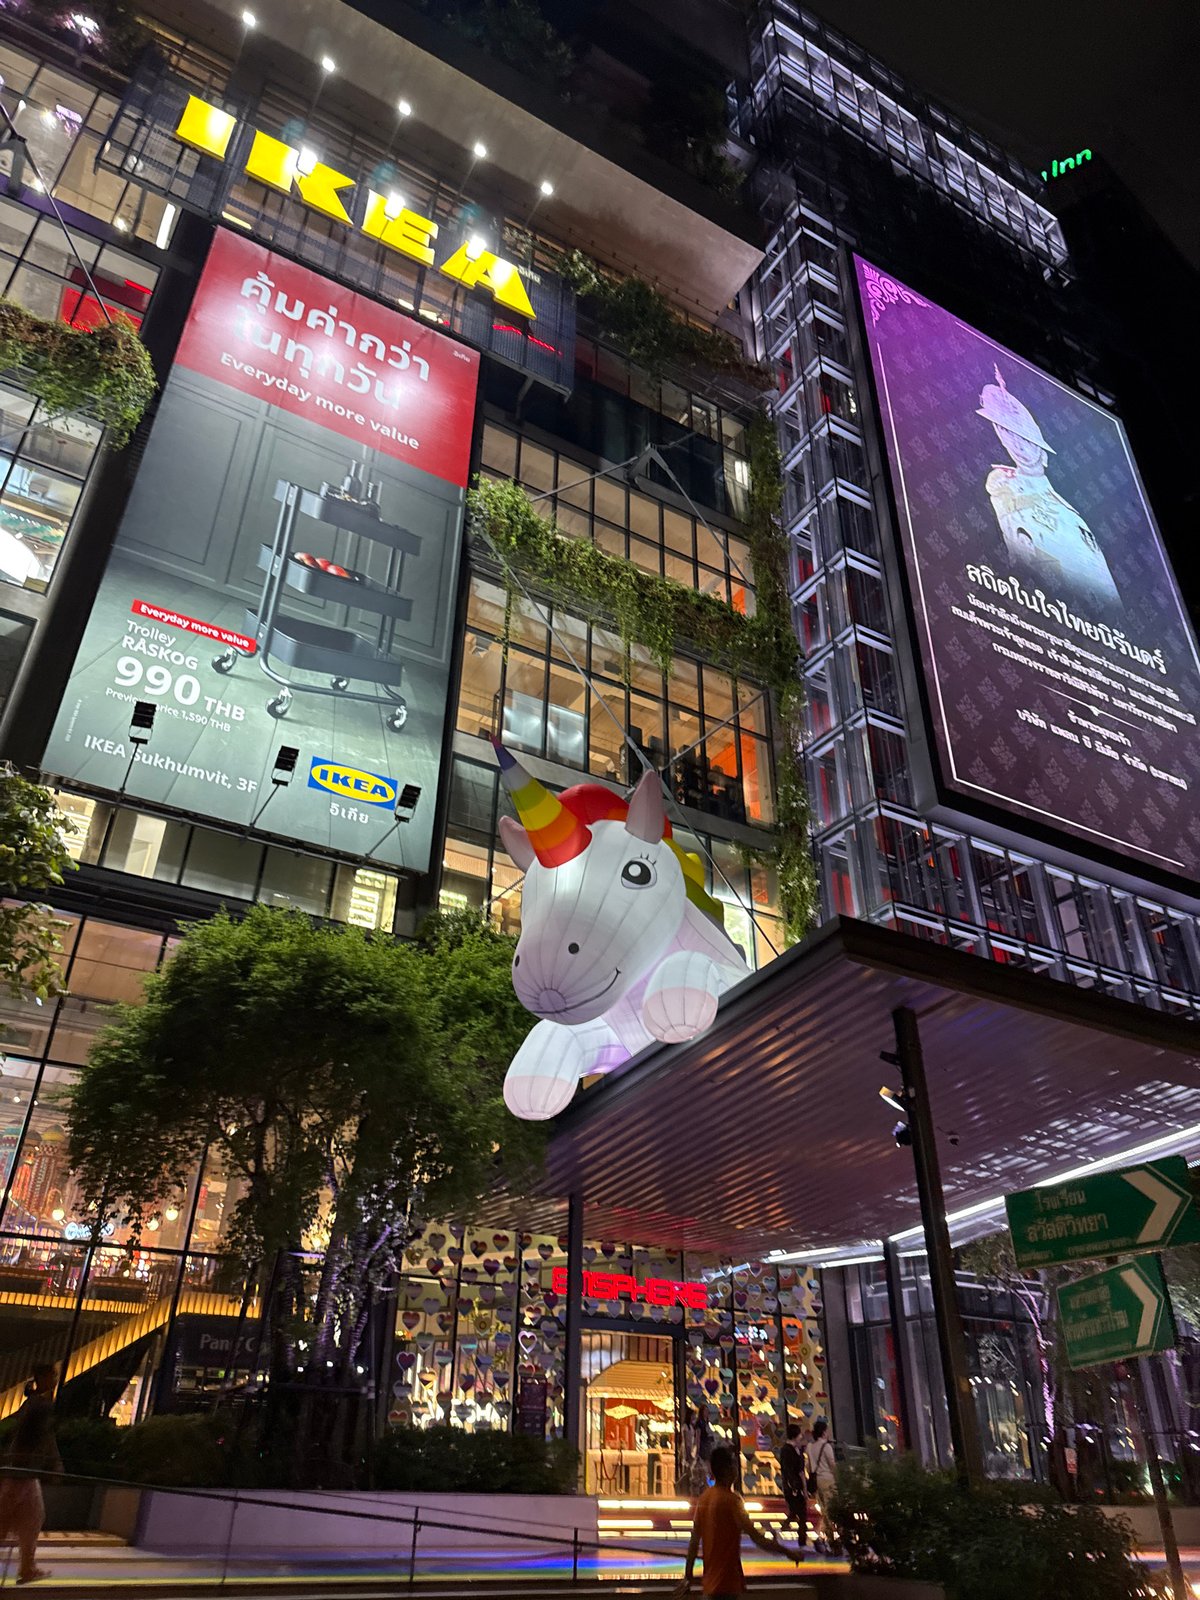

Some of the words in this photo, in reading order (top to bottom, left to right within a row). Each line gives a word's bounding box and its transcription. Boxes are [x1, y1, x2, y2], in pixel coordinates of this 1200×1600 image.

[1052, 149, 1092, 178] Inn
[175, 93, 537, 319] IKEA
[234, 304, 402, 410] ในทุกวัน
[240, 270, 430, 382] คุ้มค่ากว่า
[220, 351, 312, 402] Everyday
[315, 394, 366, 426] more
[370, 418, 420, 450] value
[126, 619, 177, 647] Trolley
[141, 603, 190, 629] Everyday
[190, 622, 220, 638] more
[220, 632, 250, 648] value
[965, 563, 1168, 675] สถิตในใจไทยนิรันดร์
[105, 686, 146, 706] Previo
[182, 710, 209, 726] 1,590
[209, 718, 231, 733] THB
[114, 655, 200, 706] 990
[204, 695, 245, 722] THB
[83, 733, 126, 759] IKEA
[130, 747, 233, 790] Sukhumvit,
[236, 776, 259, 794] 3F
[318, 767, 390, 800] IKEA
